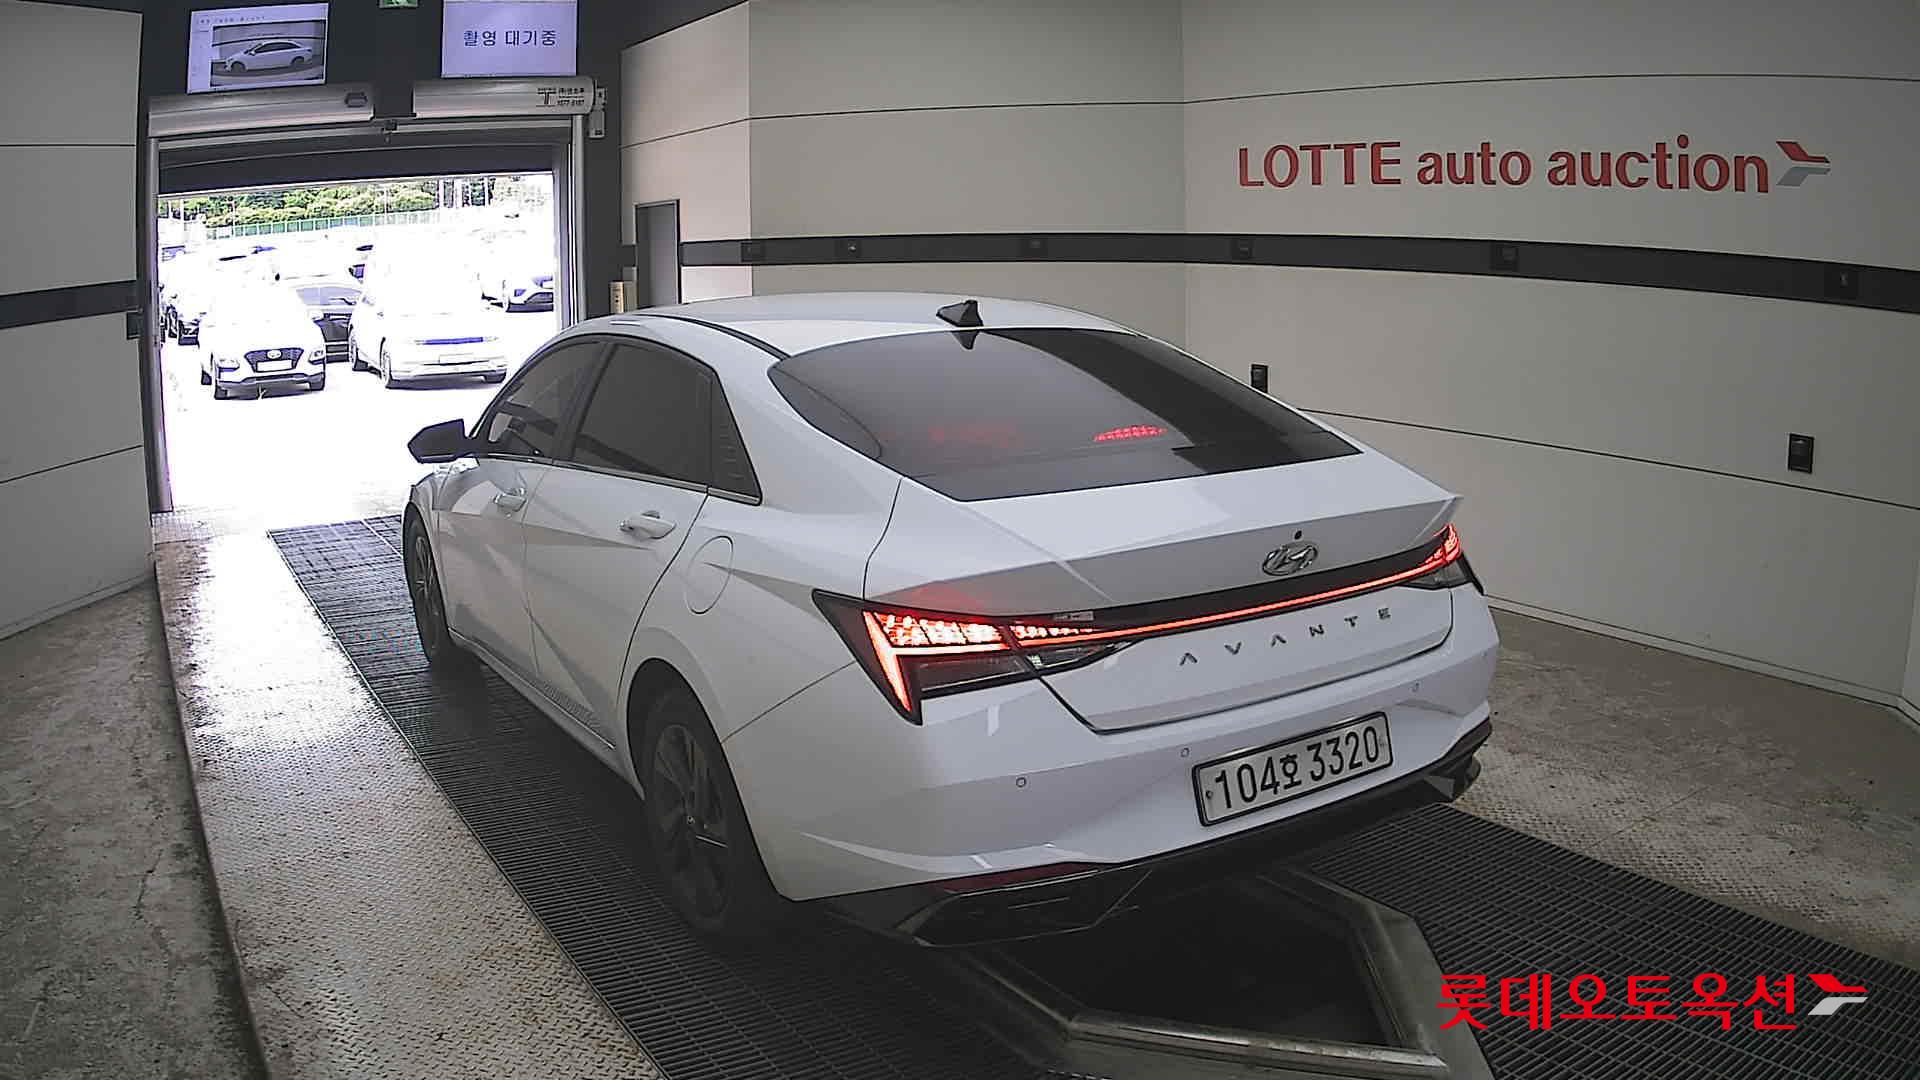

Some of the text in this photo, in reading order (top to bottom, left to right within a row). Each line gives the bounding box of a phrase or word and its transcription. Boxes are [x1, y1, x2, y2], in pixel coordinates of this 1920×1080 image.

[463, 30, 557, 47] 촬영 대기중
[1238, 134, 1769, 193] LOTTE auto auction
[1179, 607, 1391, 666] AVANTE
[1307, 725, 1380, 783] 3320
